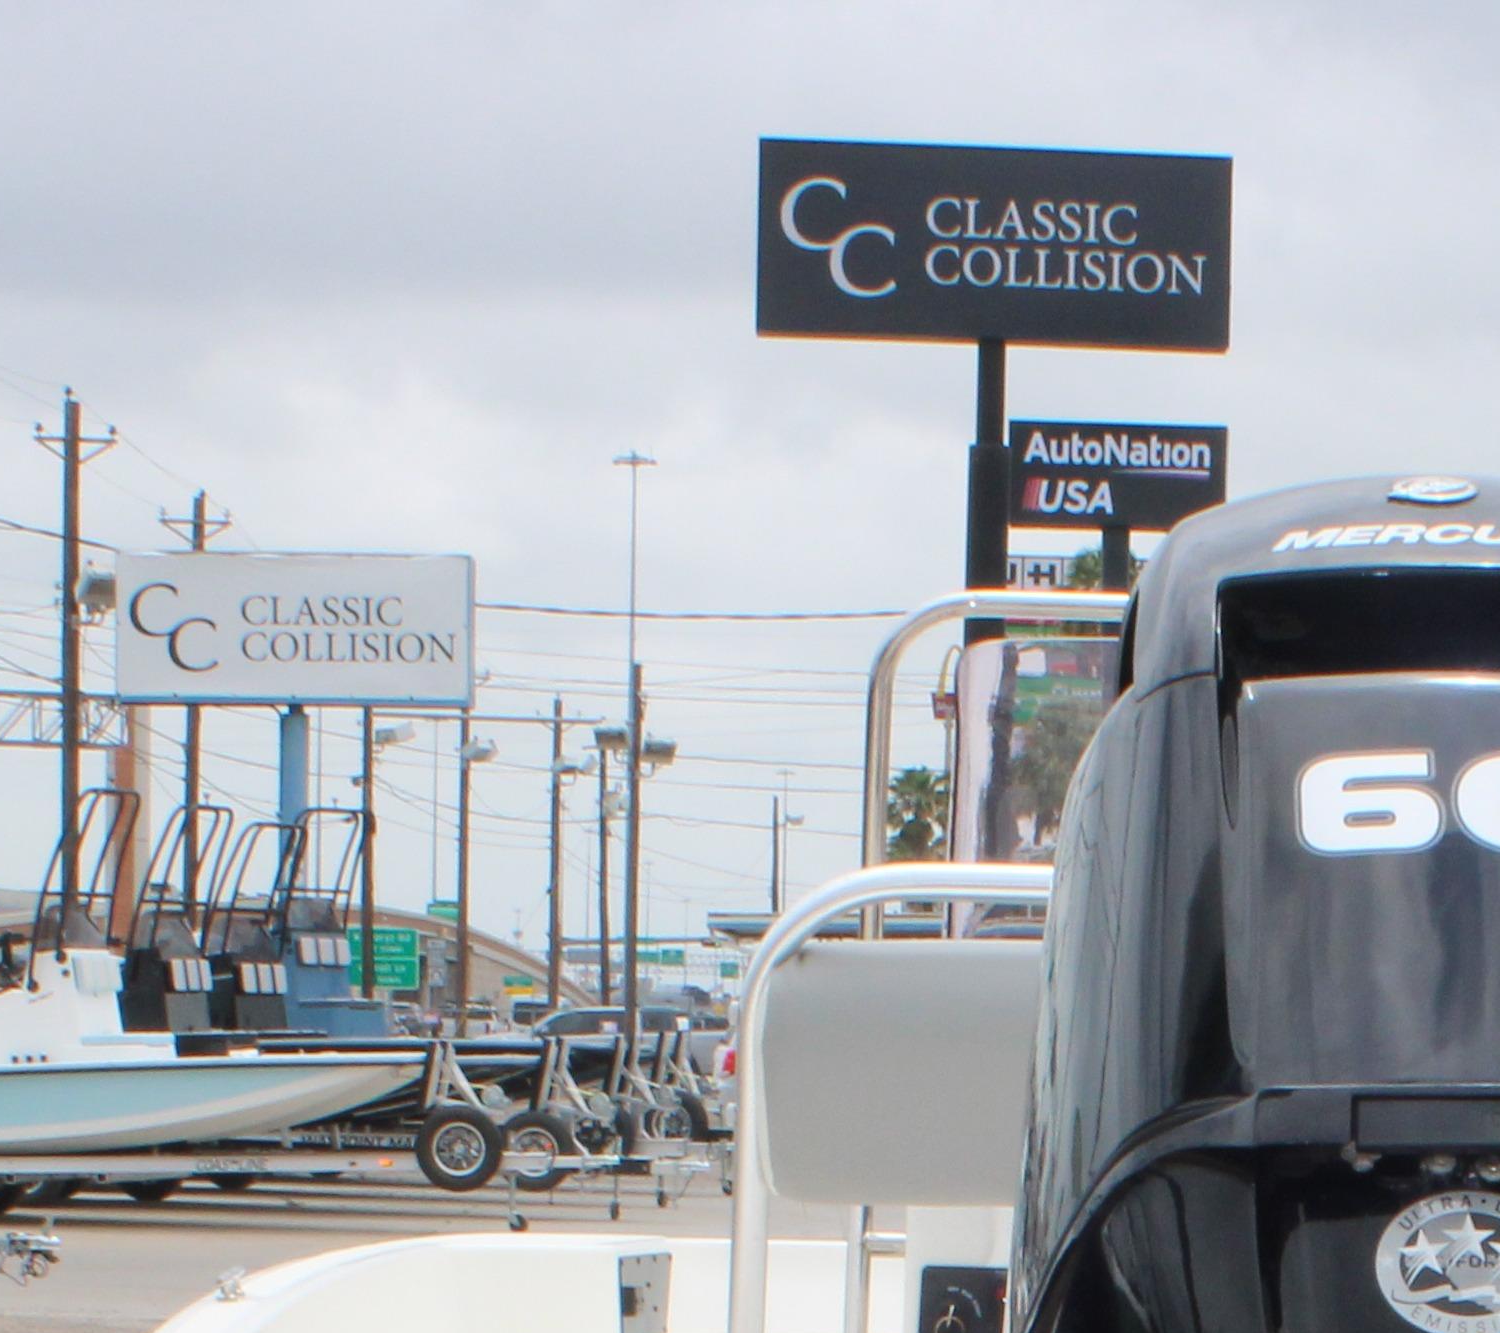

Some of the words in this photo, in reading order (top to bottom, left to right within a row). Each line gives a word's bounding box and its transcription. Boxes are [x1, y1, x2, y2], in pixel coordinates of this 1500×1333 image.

[925, 197, 1138, 246] CLASSIC
[924, 246, 1206, 295] COLLISION
[1023, 430, 1211, 469] AutoNation
[1038, 479, 1113, 515] USA
[240, 596, 403, 627] CLASSIC
[241, 631, 457, 664] COLLISION
[1399, 1194, 1473, 1232] ULTRA
